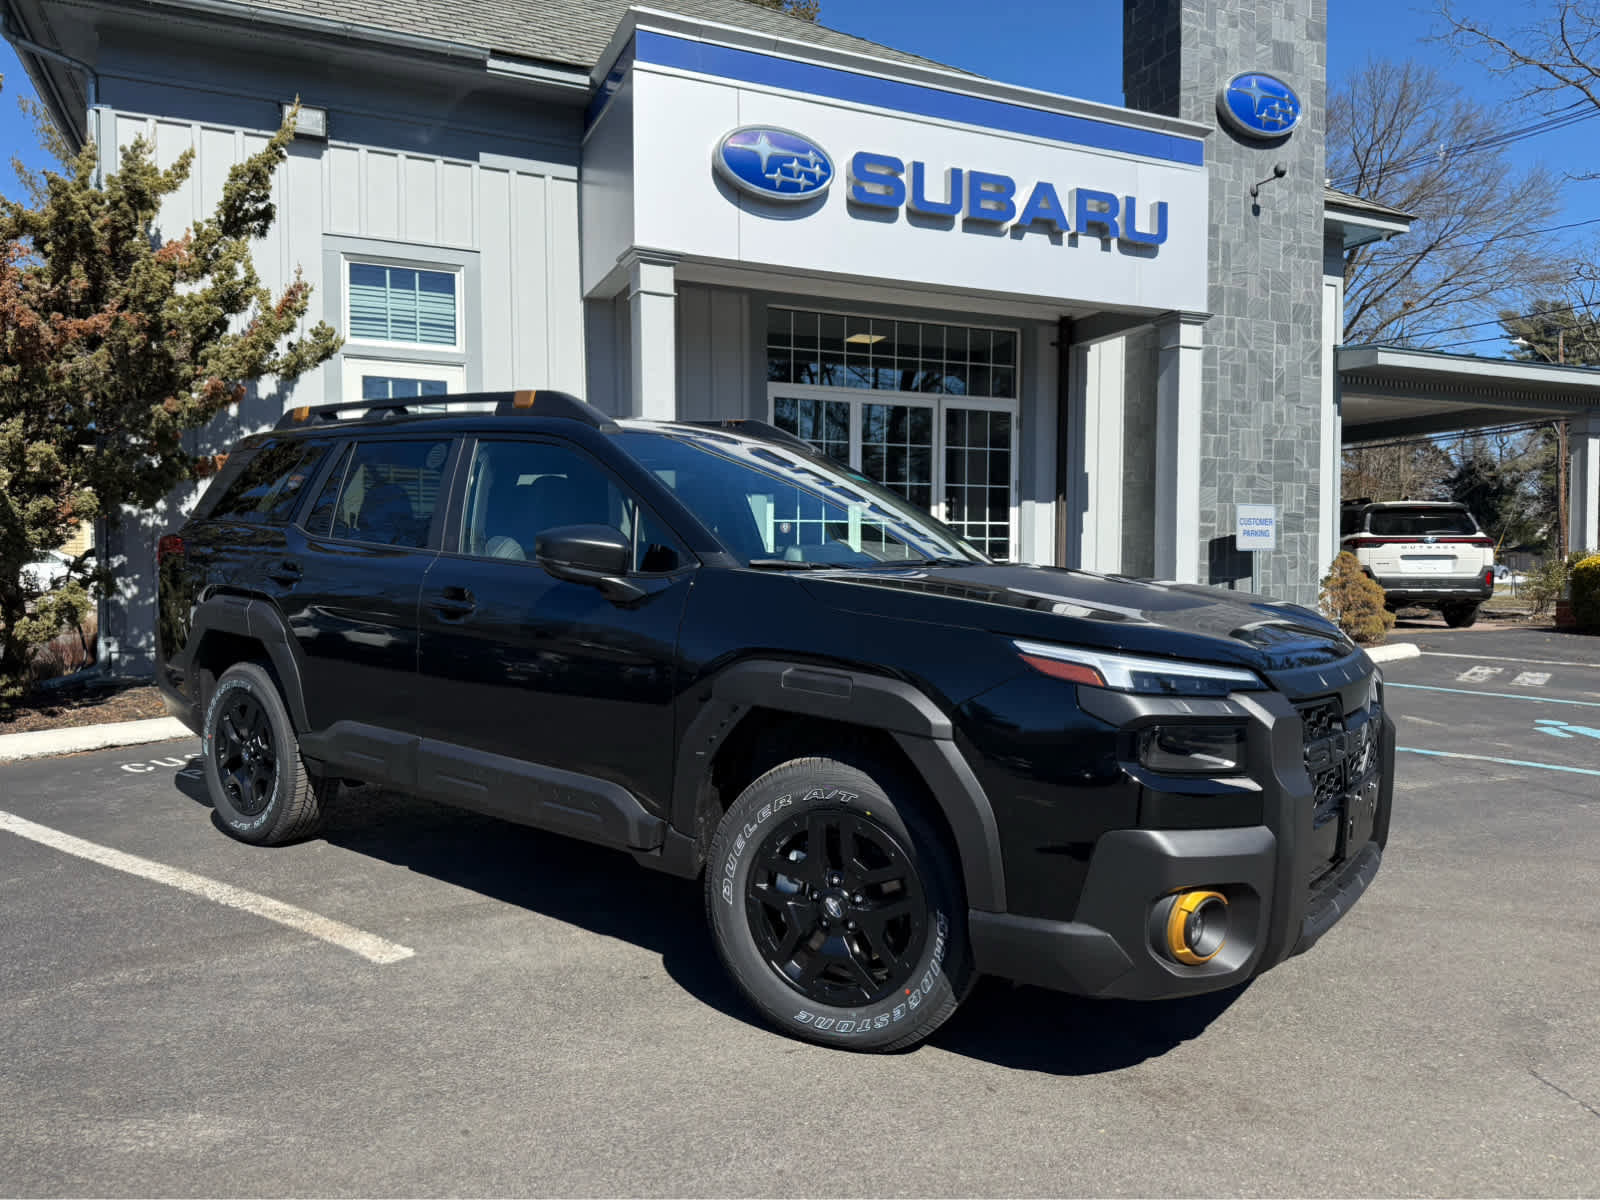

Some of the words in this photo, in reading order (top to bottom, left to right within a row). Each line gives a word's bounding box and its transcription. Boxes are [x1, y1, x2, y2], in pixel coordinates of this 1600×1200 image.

[848, 151, 1168, 245] SUBARU
[1239, 518, 1273, 526] CUSTOMER
[1242, 529, 1270, 537] PARKING
[722, 794, 793, 905] DUELER
[803, 788, 858, 802] A/T
[793, 909, 949, 1033] BRIDGESTONE
